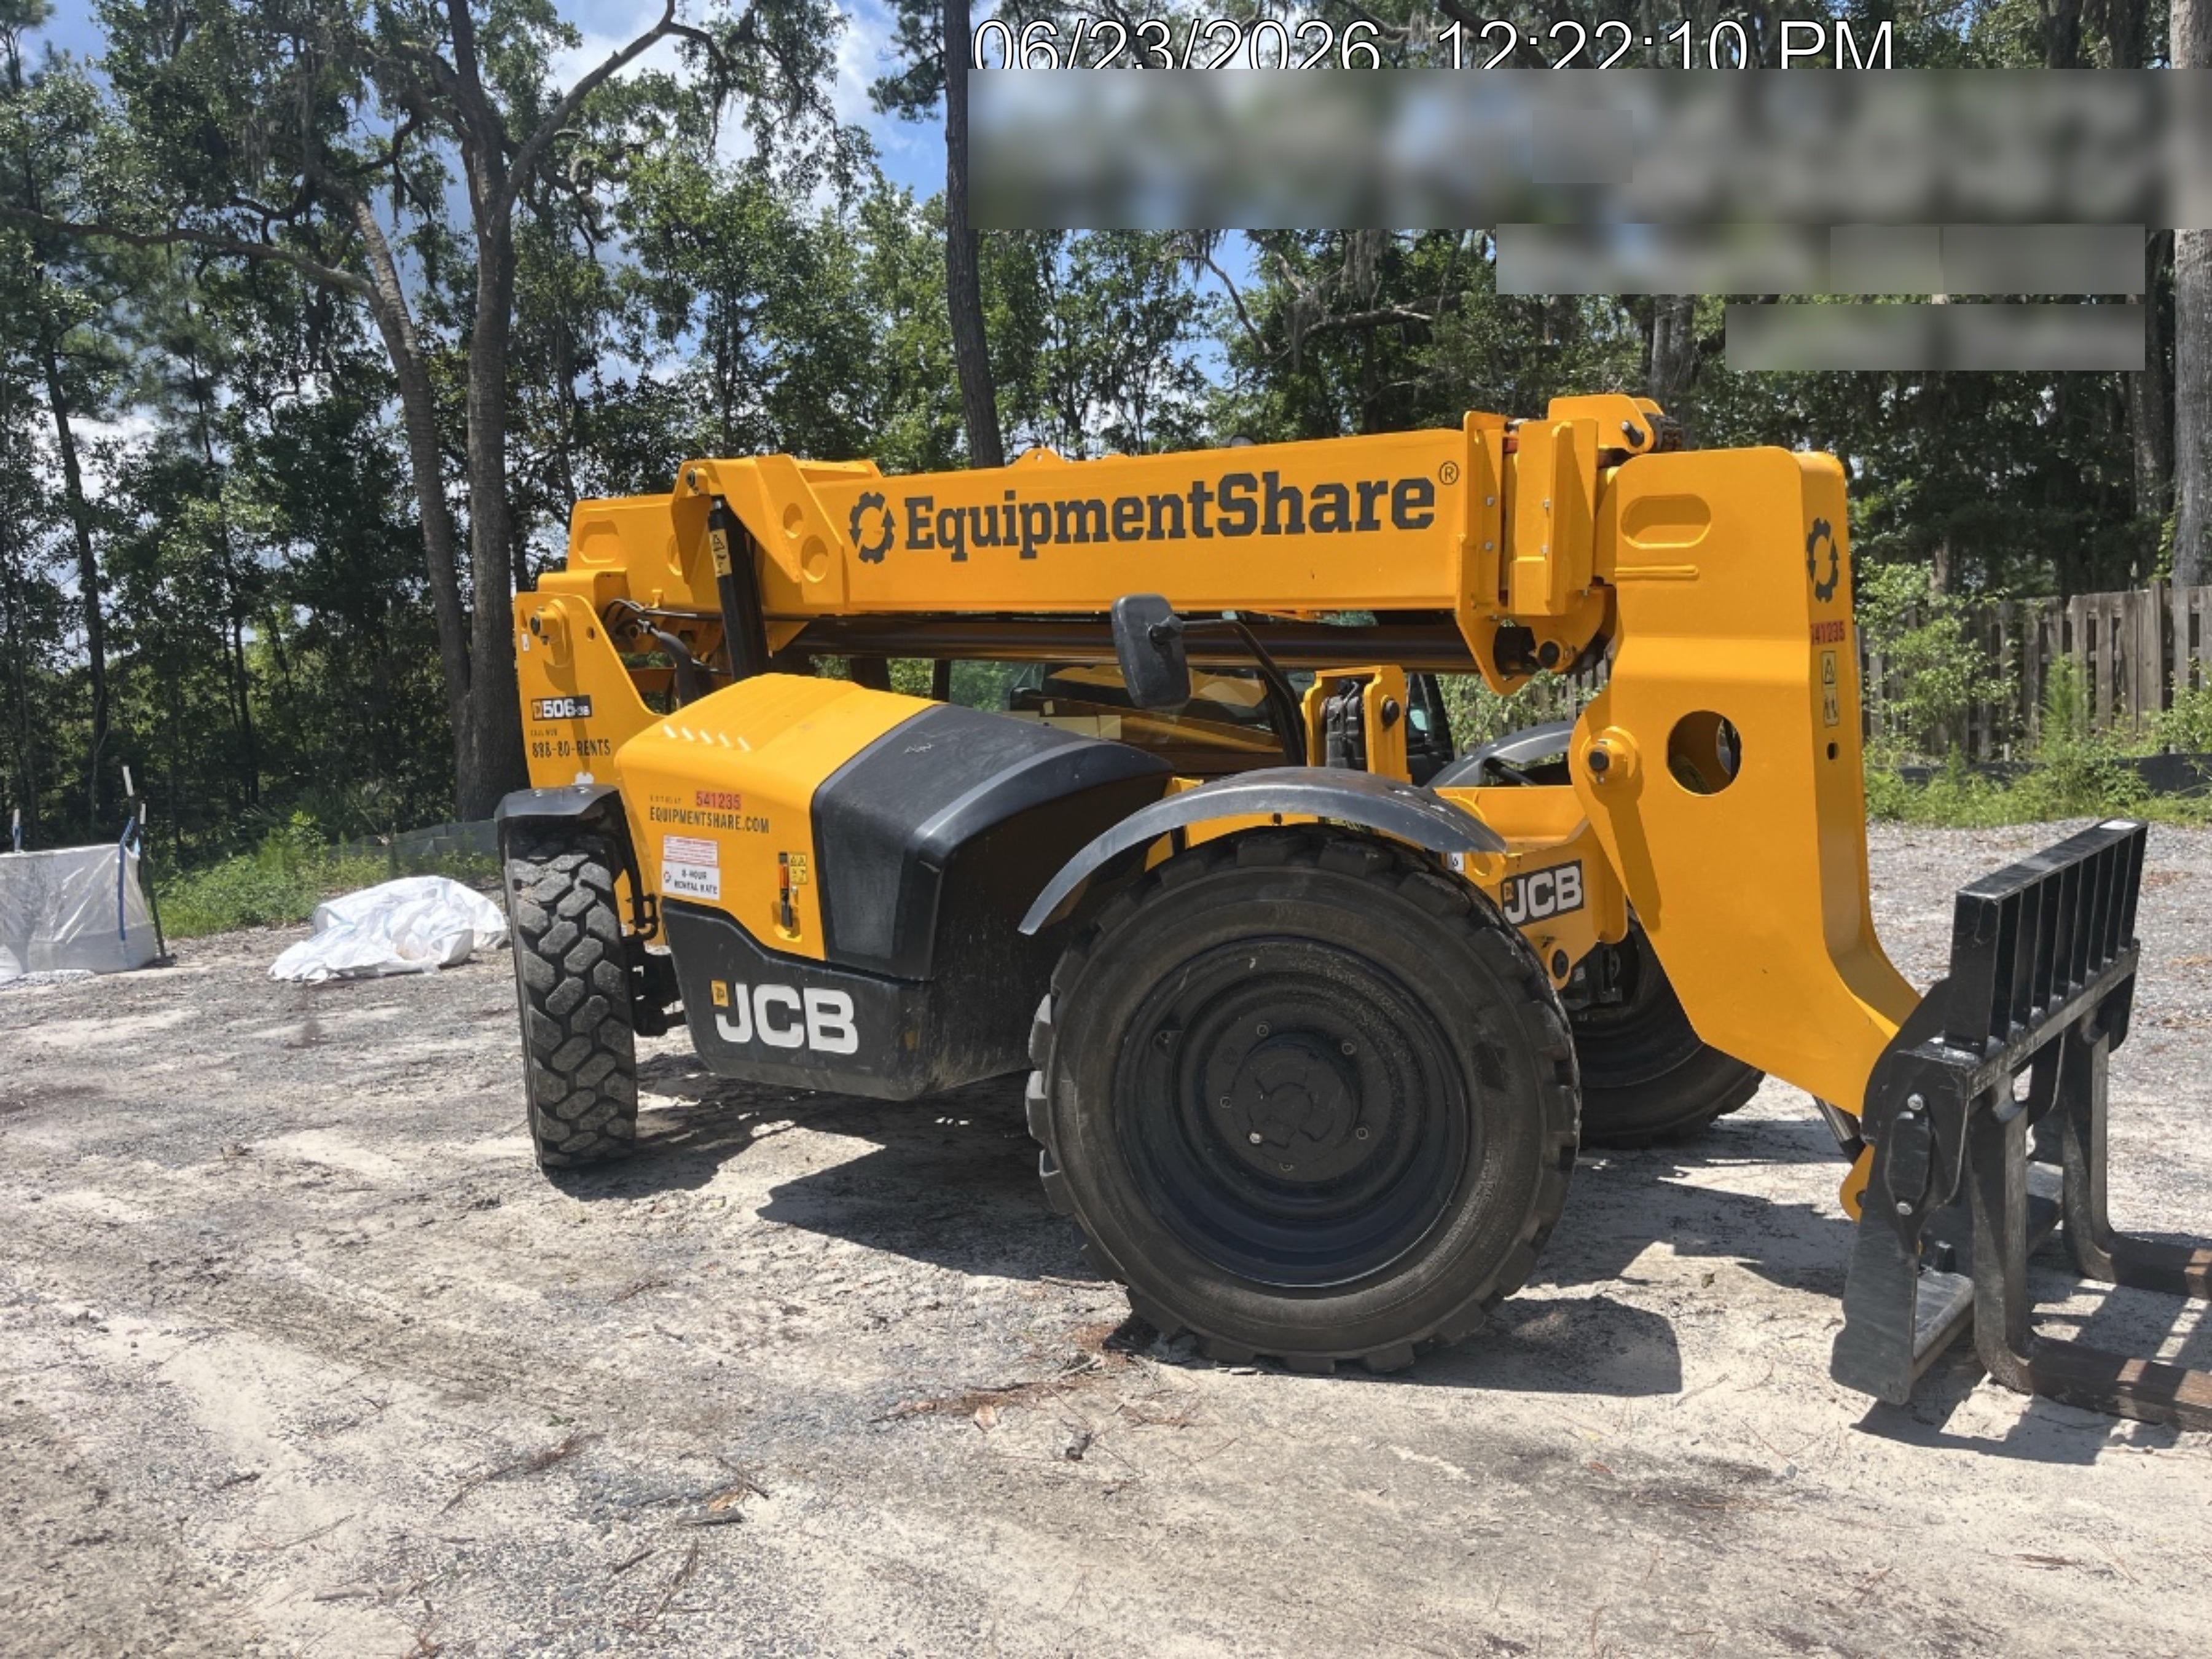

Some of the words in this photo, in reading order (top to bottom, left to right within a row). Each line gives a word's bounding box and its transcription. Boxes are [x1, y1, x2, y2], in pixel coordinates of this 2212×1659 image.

[650, 806, 770, 834] EQUIPMENTSHARE.COM
[696, 790, 741, 810] 541235
[1504, 865, 1583, 925] JCB
[715, 982, 859, 1055] JCB
